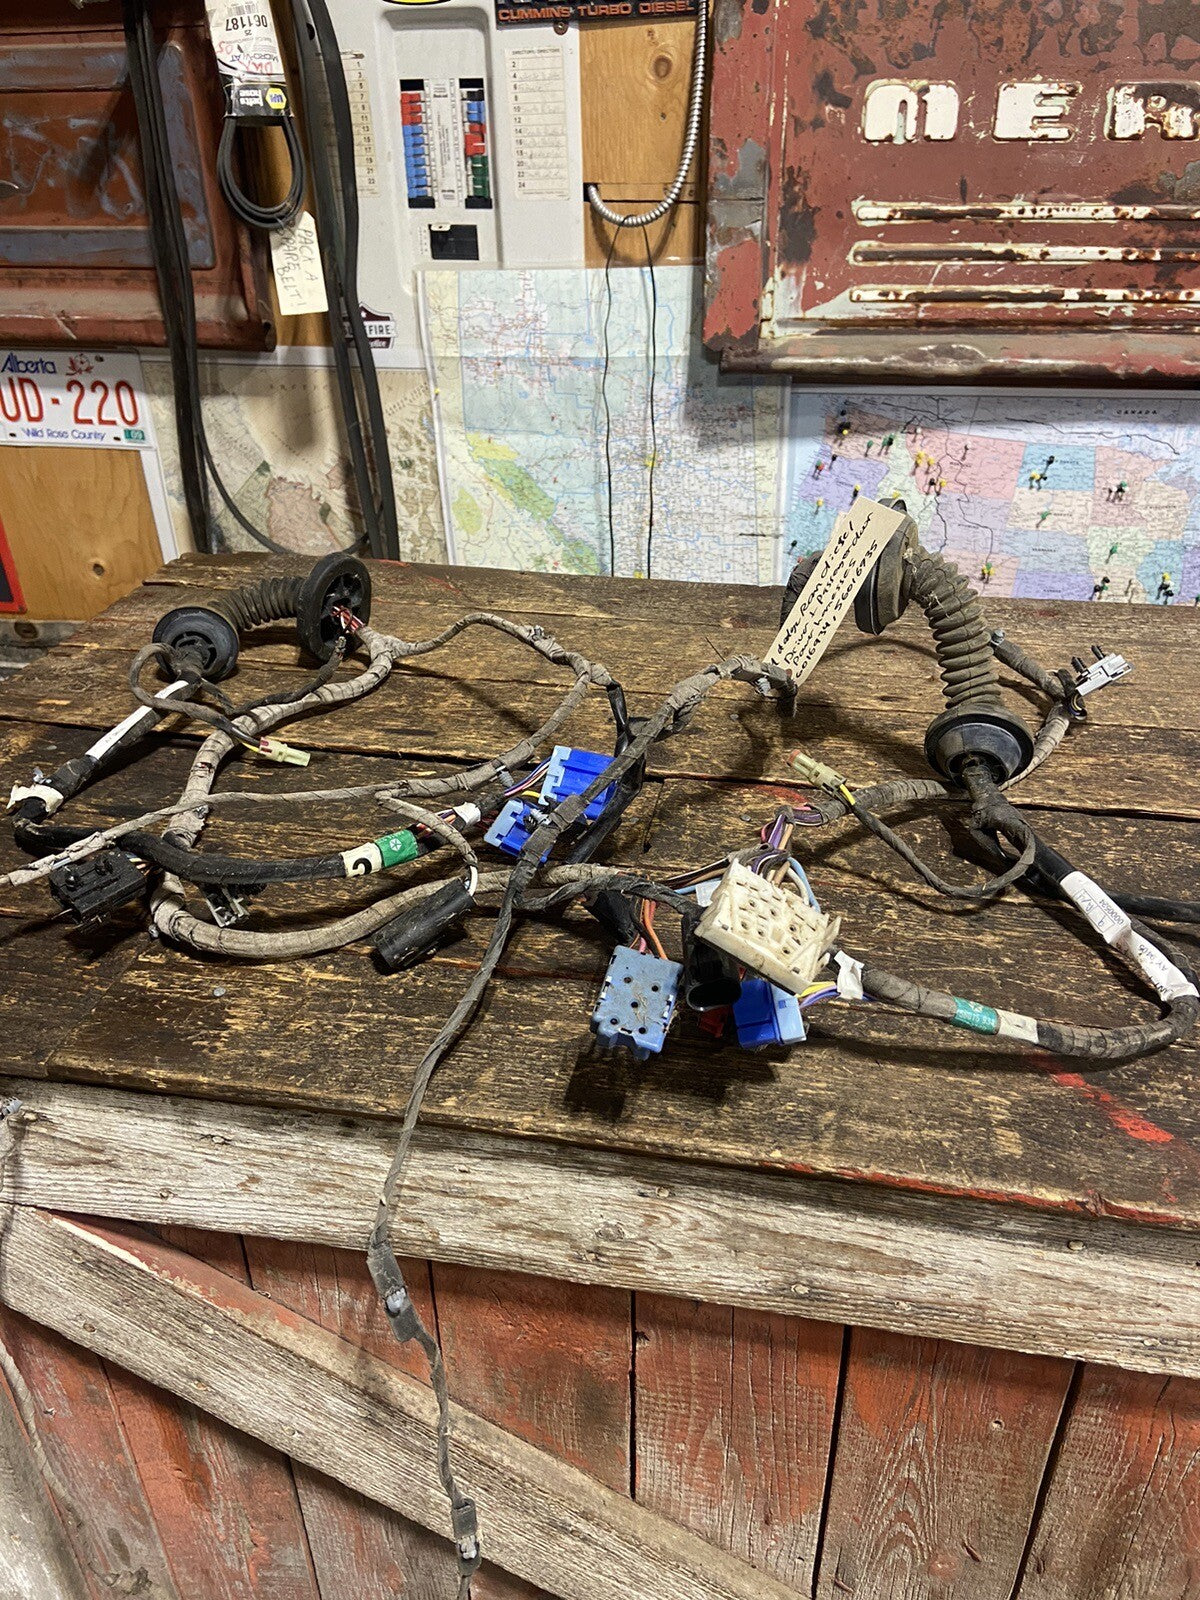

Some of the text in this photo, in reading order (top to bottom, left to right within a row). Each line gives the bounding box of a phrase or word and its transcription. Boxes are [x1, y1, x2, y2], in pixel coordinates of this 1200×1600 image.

[498, 0, 695, 21] CUMMINS TURBO DIESEL
[225, 14, 268, 31] 061187
[1, 352, 57, 374] Alberta
[21, 428, 106, 441] Wild Rose Country
[800, 583, 822, 616] Ram
[821, 521, 853, 578] diesel
[784, 623, 808, 664] Driver
